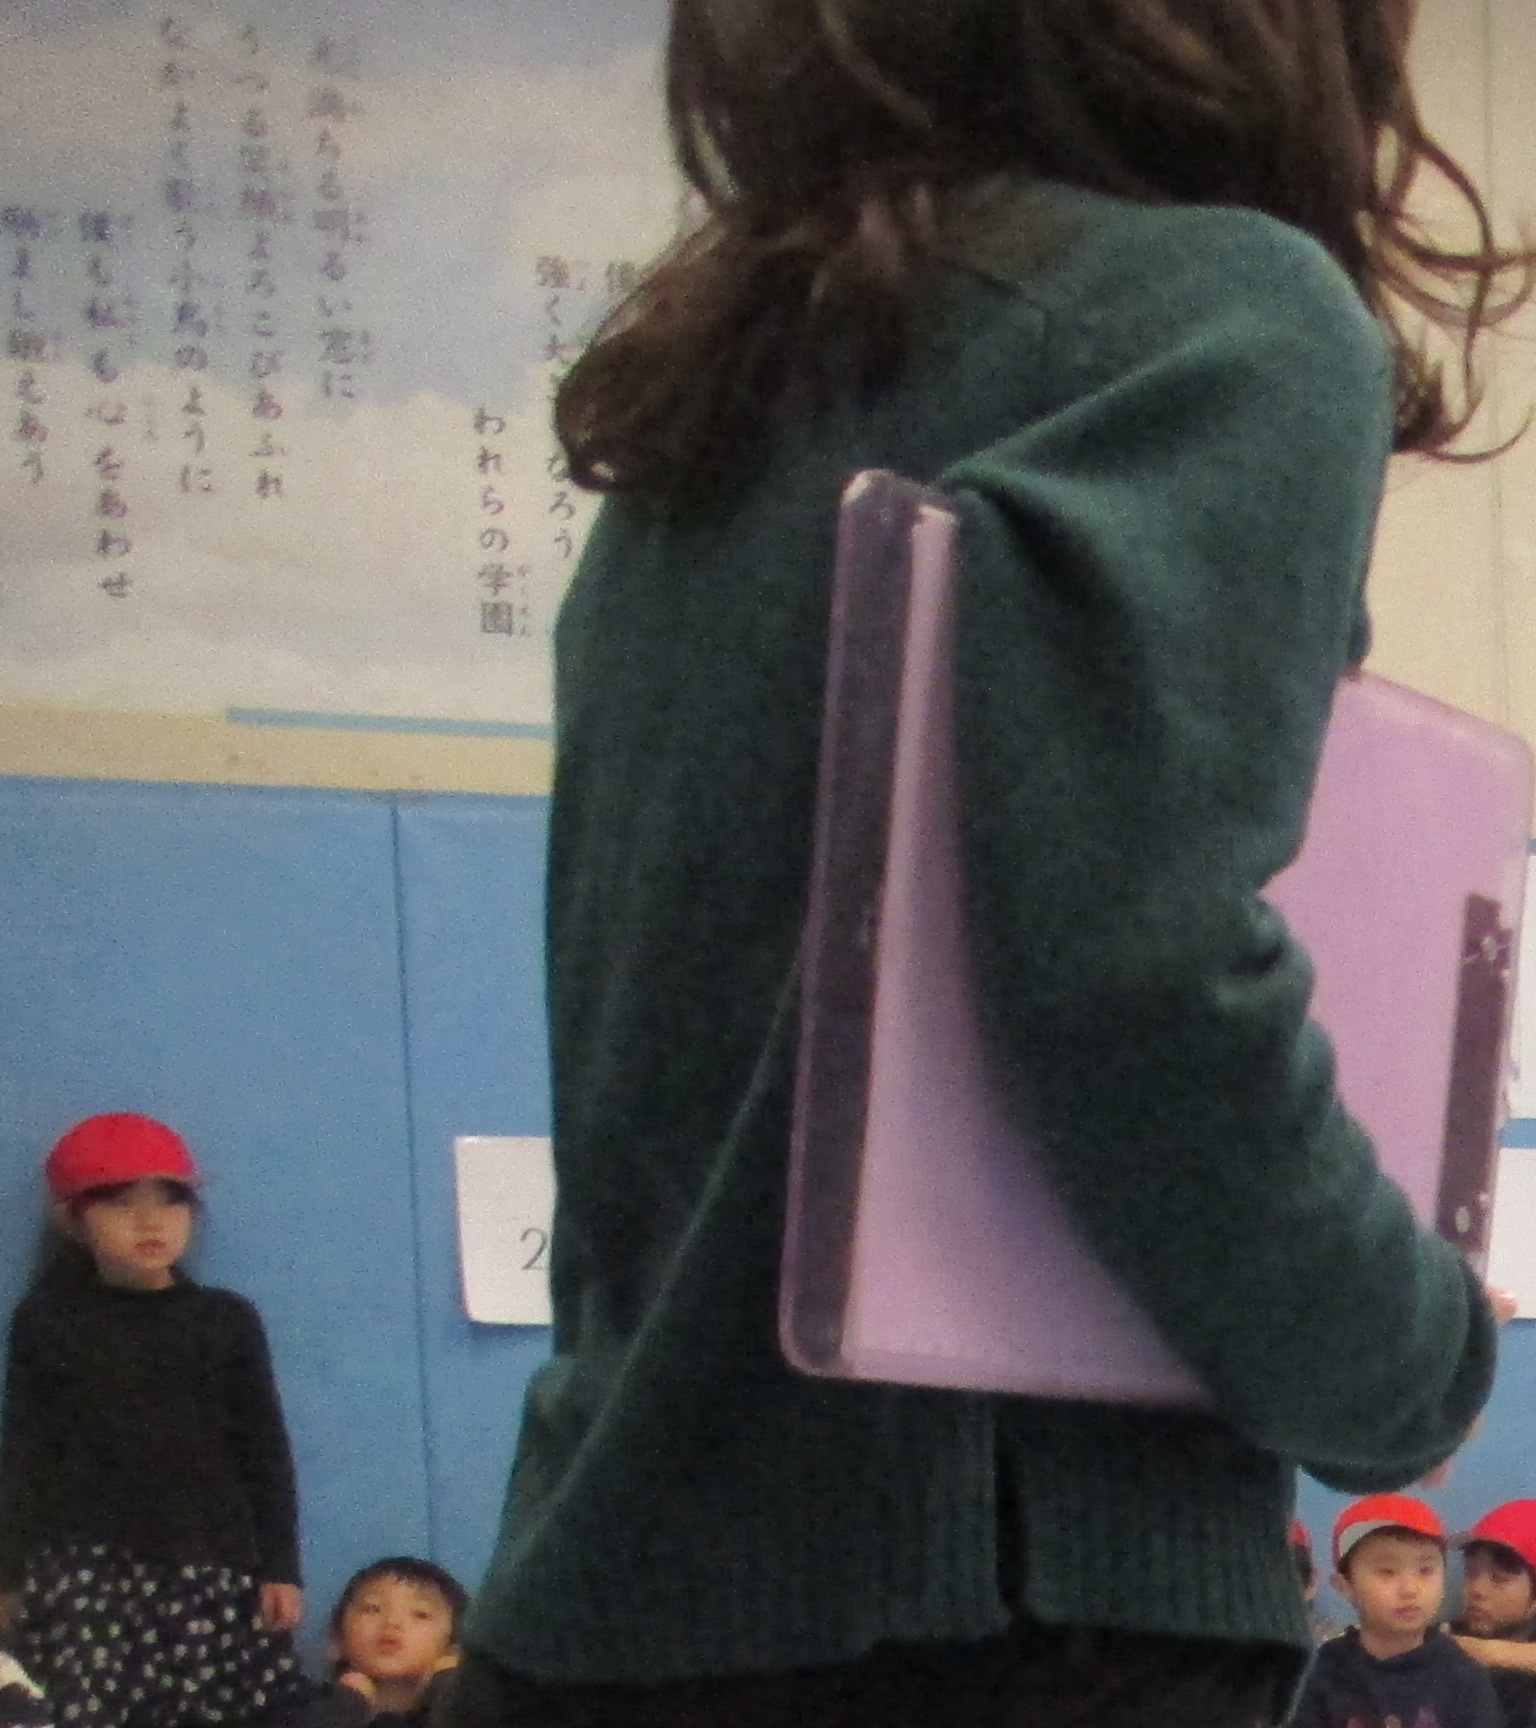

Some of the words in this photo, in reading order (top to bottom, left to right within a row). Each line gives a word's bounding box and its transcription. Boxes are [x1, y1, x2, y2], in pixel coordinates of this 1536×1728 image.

[472, 406, 514, 638] われらの学園
